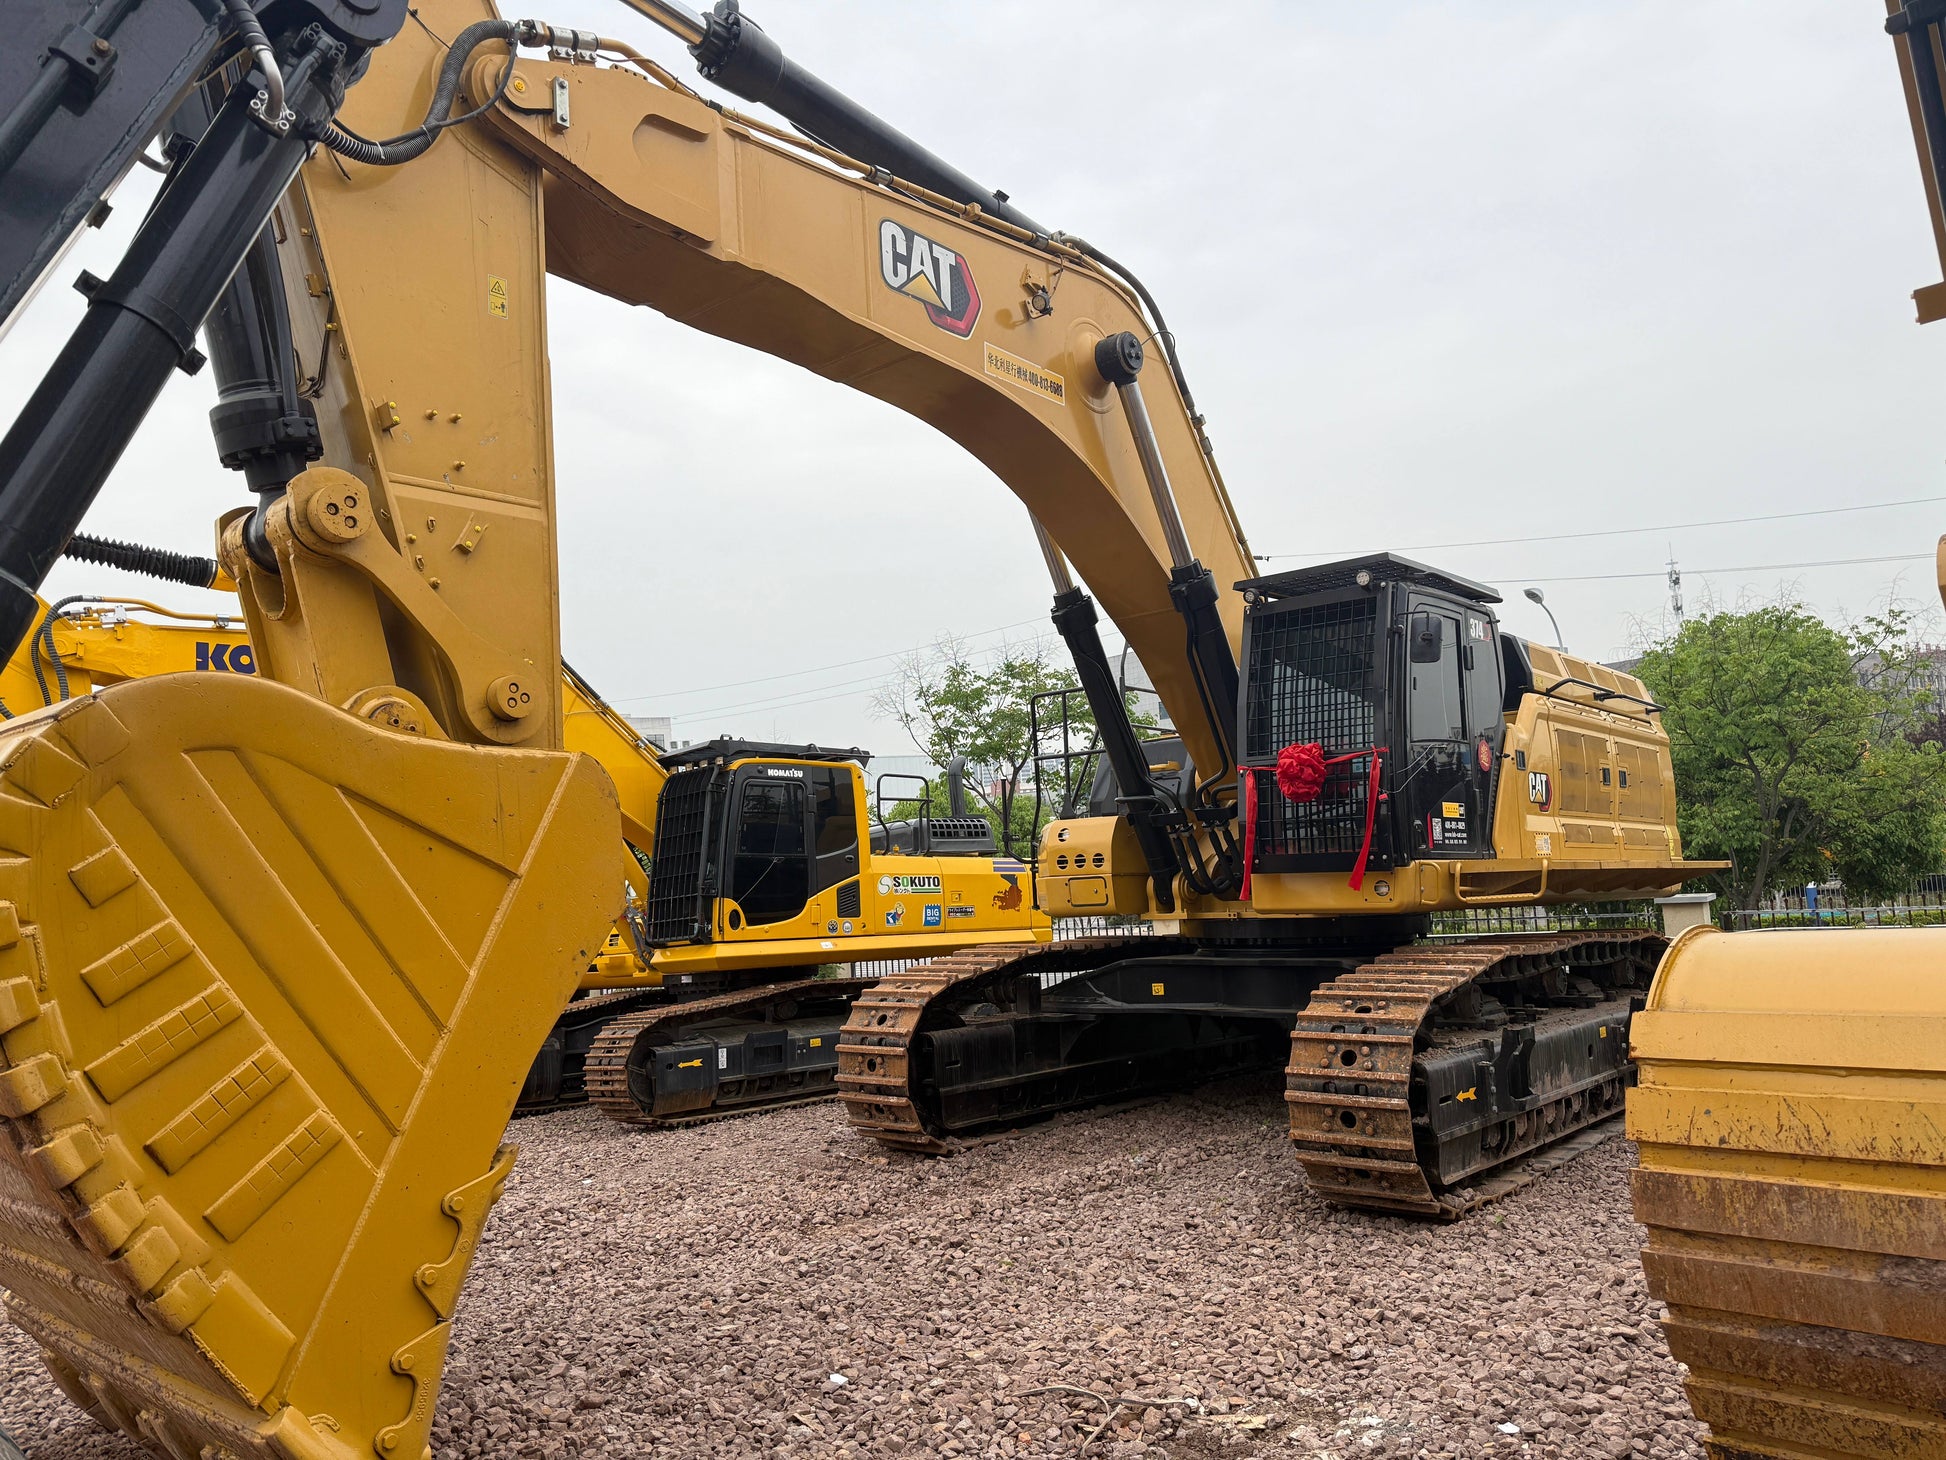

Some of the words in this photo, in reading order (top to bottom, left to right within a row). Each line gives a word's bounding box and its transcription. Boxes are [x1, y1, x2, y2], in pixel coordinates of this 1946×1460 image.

[880, 221, 956, 311] CAT
[1470, 618, 1484, 639] 374
[767, 768, 803, 778] KOMATSU
[1528, 772, 1547, 803] CAT
[893, 876, 940, 888] SOKUTO
[926, 908, 940, 917] BIG
